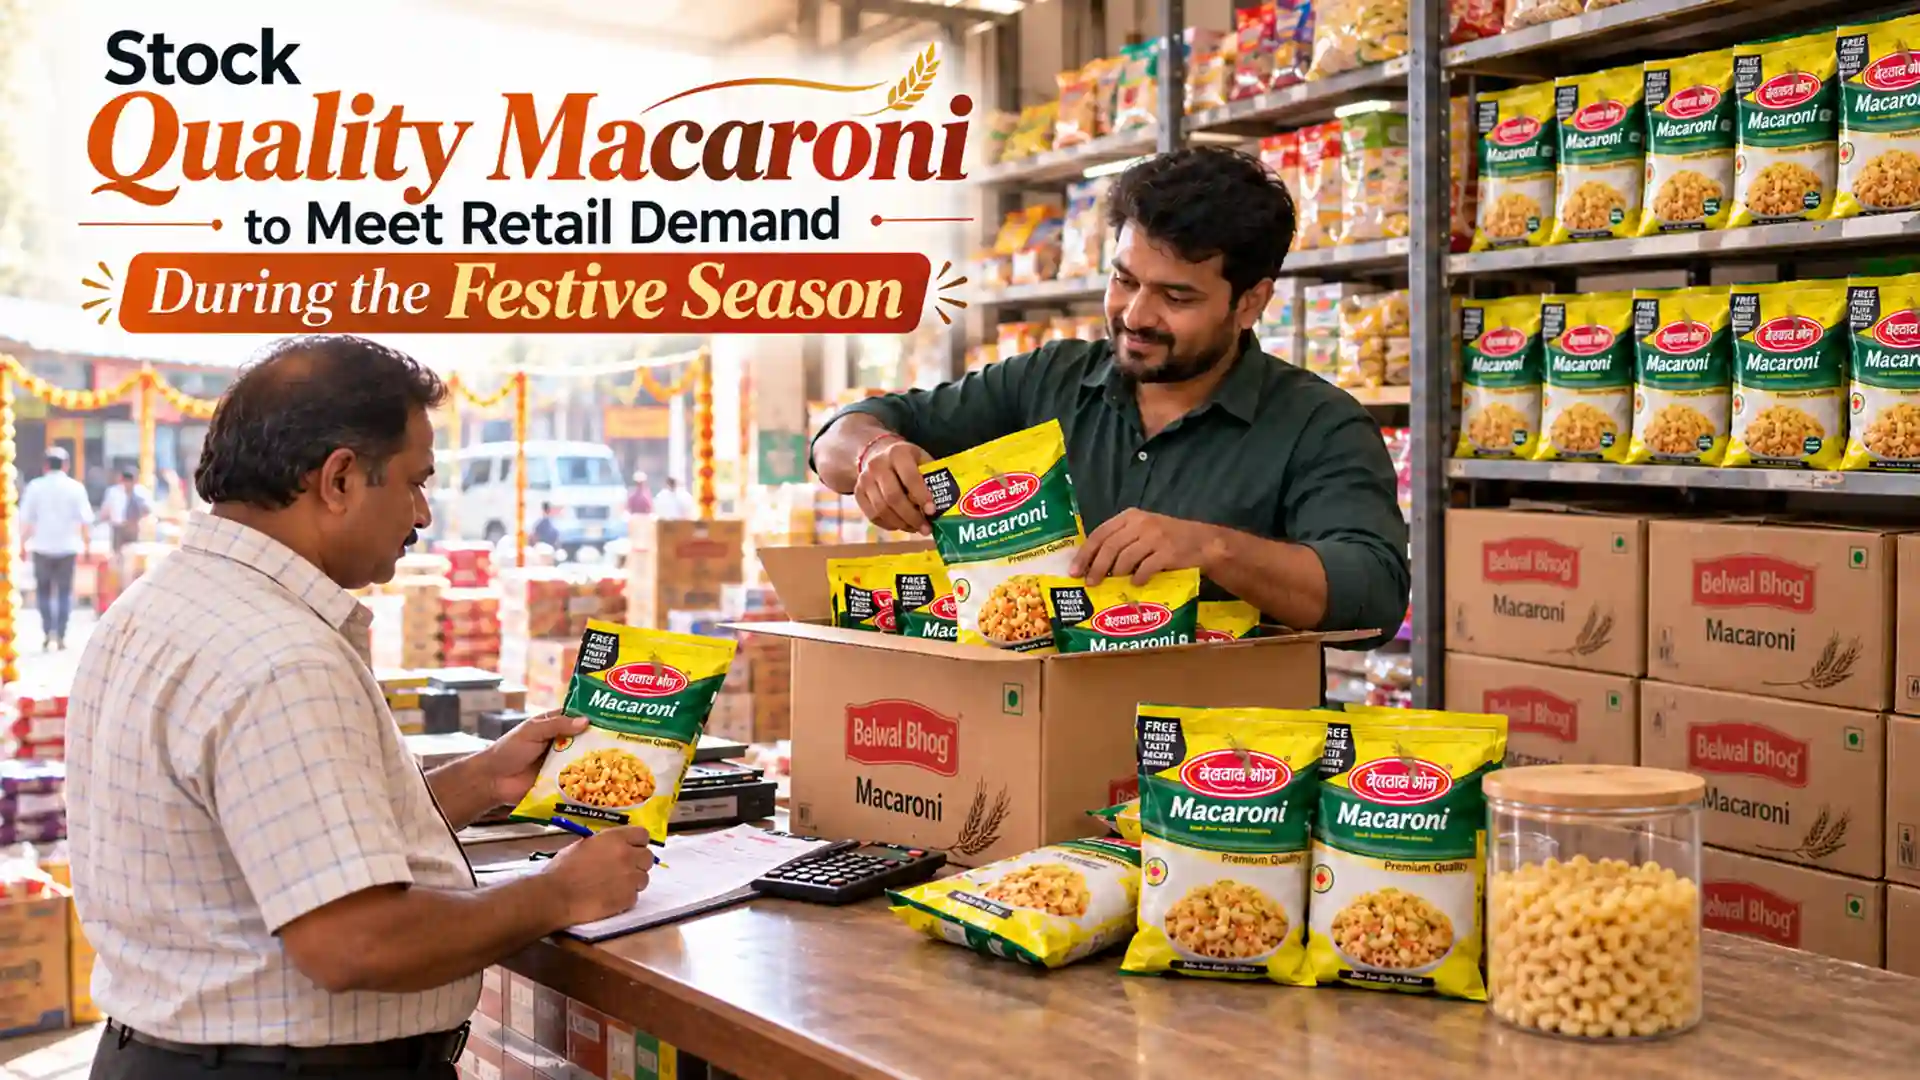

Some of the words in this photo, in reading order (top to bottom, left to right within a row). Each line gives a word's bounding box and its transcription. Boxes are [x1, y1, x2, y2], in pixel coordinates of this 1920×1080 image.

[1855, 93, 1920, 113] Macaro
[1656, 115, 1718, 137] Macaroni
[1748, 104, 1818, 129] Macaroni
[1566, 128, 1622, 149] Macaroni
[1487, 142, 1539, 162] Macaroni
[1471, 355, 1526, 372] Macaroni
[1553, 355, 1613, 372] Macaroni
[1646, 352, 1711, 372] Macaroni
[1746, 351, 1821, 371] Macaroni
[1865, 349, 1920, 368] Macar
[958, 500, 1049, 545] Macaroni
[1701, 569, 1755, 594] Belwal
[1760, 570, 1804, 604] Bhog
[1493, 593, 1565, 623] Macaroni
[1090, 631, 1175, 652] Macaroni
[1706, 617, 1795, 652] Macaroni
[588, 689, 680, 717] Macaroni
[1145, 721, 1178, 733] FREE
[1327, 728, 1349, 738] REE
[854, 717, 901, 748] Belwal
[906, 720, 949, 764] Bhog
[1697, 733, 1748, 762] Belwal
[1753, 740, 1798, 777] Bhog
[856, 776, 943, 823] Macaroni
[1169, 795, 1289, 823] Macaroni
[1702, 786, 1790, 825] Macaroni
[1336, 801, 1450, 830] Macaroni
[1221, 853, 1268, 865] Premium
[1271, 853, 1303, 866] Quality
[1384, 861, 1431, 873] Premium
[1433, 862, 1467, 875] Quality
[1749, 898, 1791, 937] Bhog
